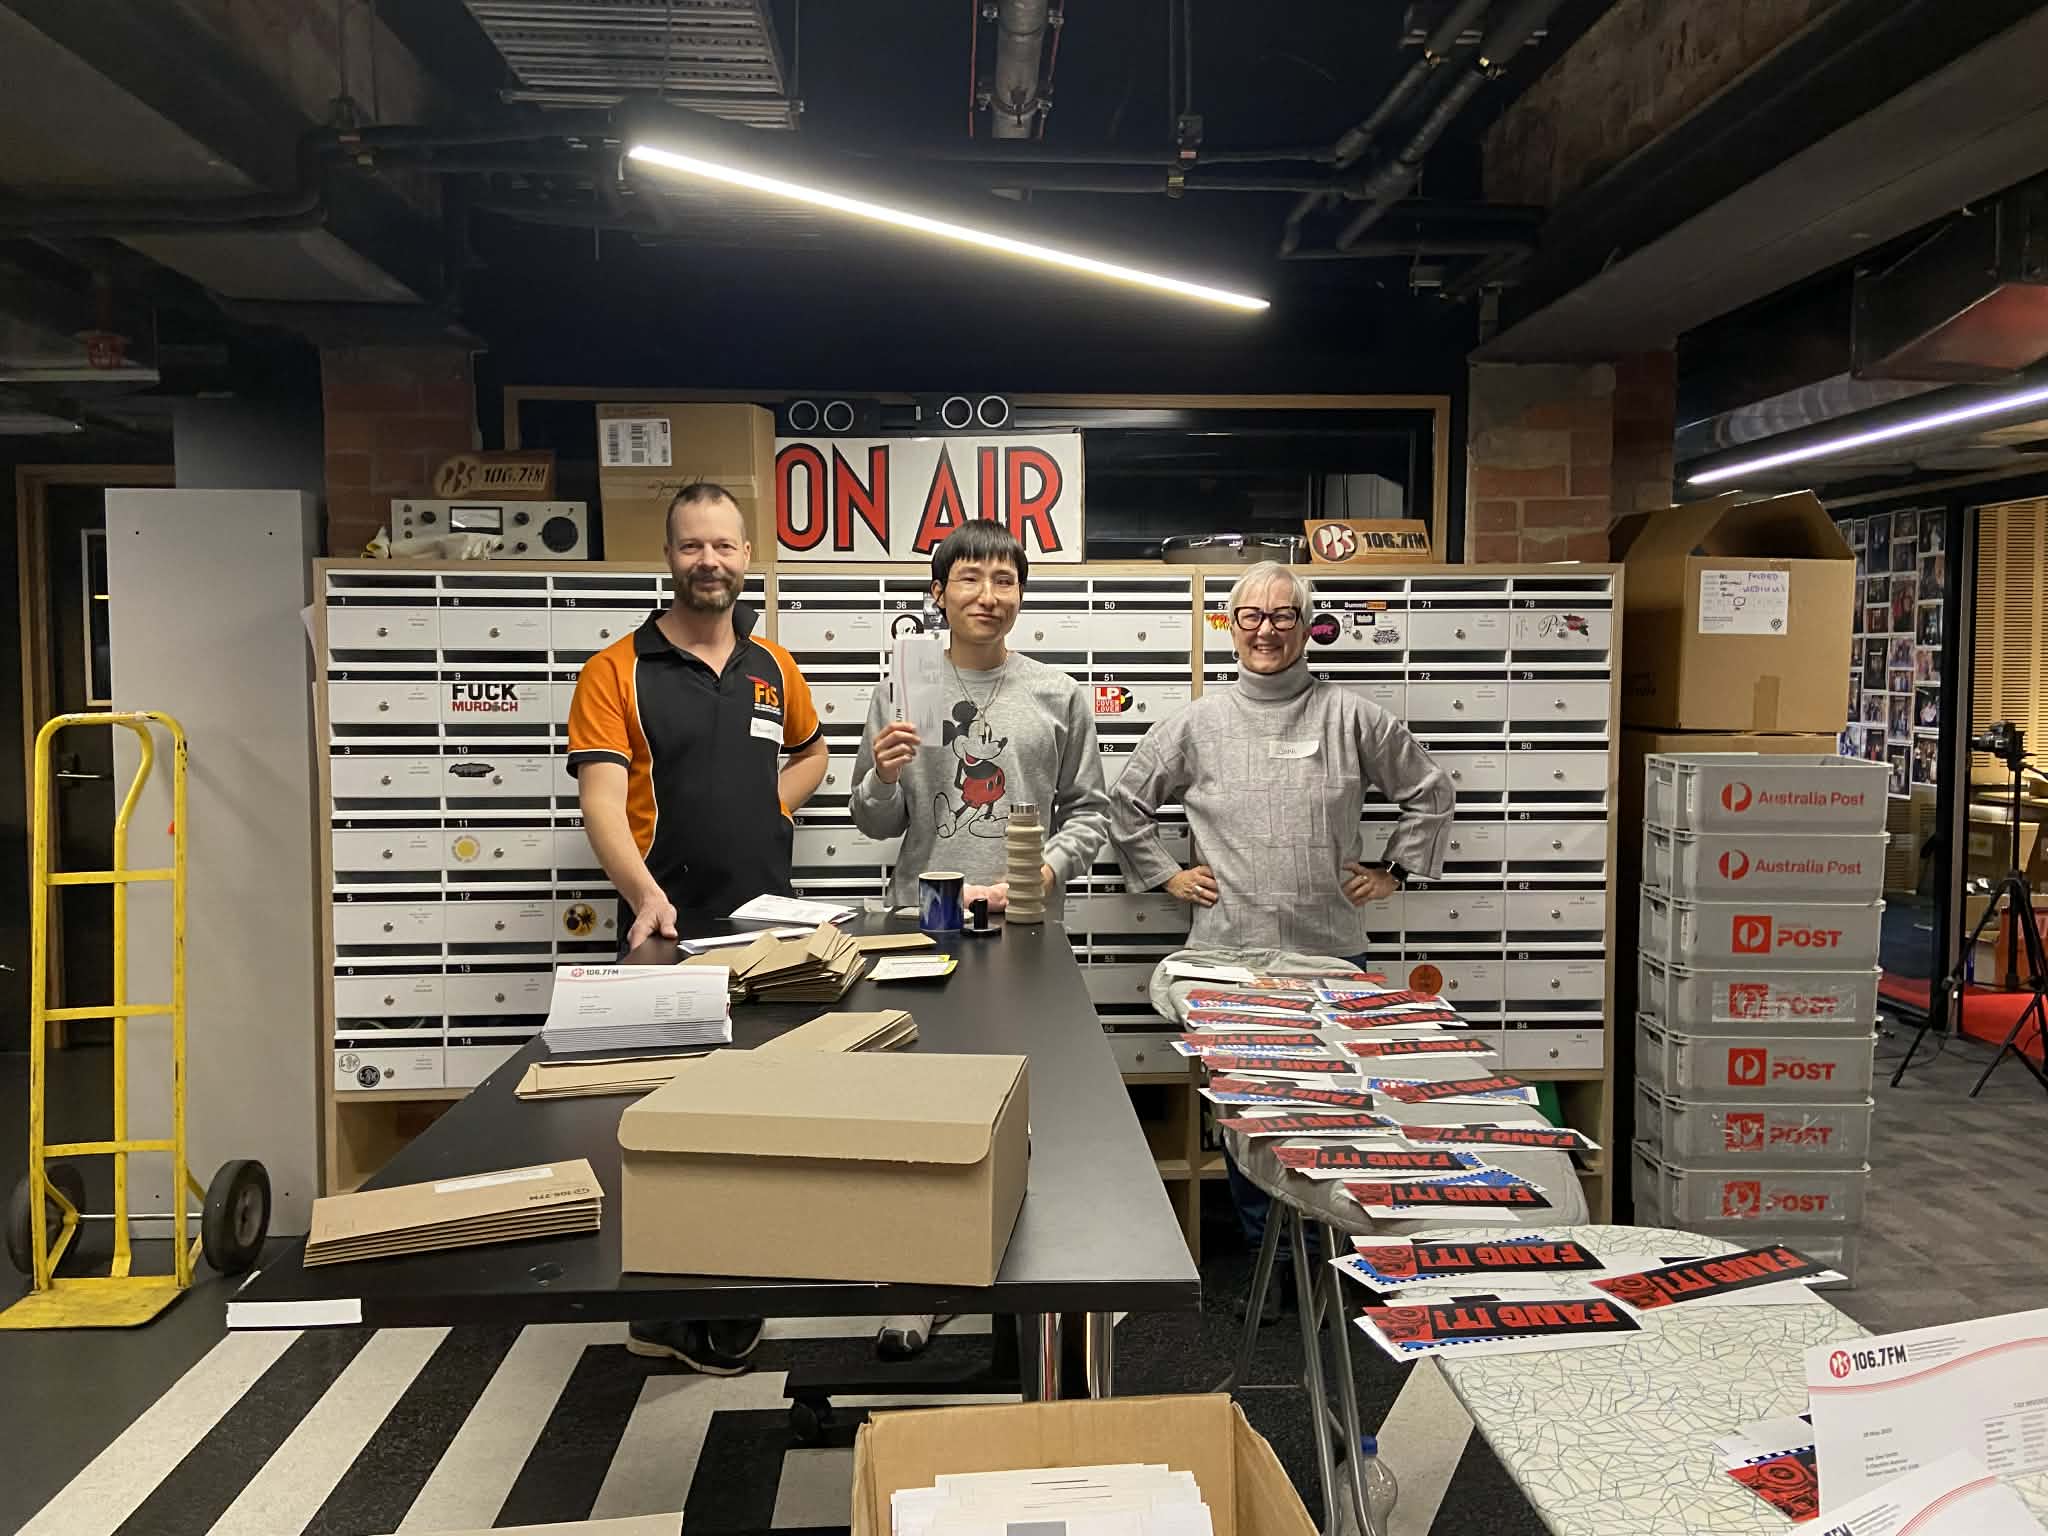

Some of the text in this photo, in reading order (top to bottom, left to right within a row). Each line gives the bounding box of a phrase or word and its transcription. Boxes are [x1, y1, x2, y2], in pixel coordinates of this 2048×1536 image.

[776, 441, 1063, 556] ON AIR
[1317, 525, 1426, 560] PBS 106.7FM
[566, 598, 576, 608] 15
[790, 601, 802, 610] 29
[1104, 601, 1116, 610] 50
[1217, 601, 1228, 610] 57
[1422, 600, 1432, 608] 71
[1524, 600, 1535, 608] 78
[342, 672, 348, 680] 2
[455, 672, 461, 680] 9
[566, 672, 576, 681] 16
[1104, 674, 1114, 682] 51
[1217, 673, 1228, 681] 58
[1420, 672, 1430, 680] 72
[1522, 672, 1534, 680] 79
[452, 684, 519, 700] FUCK
[754, 682, 779, 707] FIS
[1096, 688, 1120, 700] LP
[452, 702, 518, 712] MURDCH
[344, 746, 350, 755] 3
[457, 746, 468, 754] 10
[1104, 744, 1114, 752] 52
[1758, 792, 1864, 806] Australia Post
[346, 820, 352, 828] 4
[458, 820, 469, 828] 11
[570, 818, 580, 826] 18
[1754, 858, 1862, 874] Australia Post
[346, 894, 353, 902] 5
[460, 892, 470, 900] 12
[1777, 930, 1843, 948] POST
[348, 967, 354, 976] 6
[460, 964, 471, 973] 13
[348, 1040, 355, 1048] 7
[460, 1037, 472, 1046] 14
[1772, 1062, 1836, 1081] POST
[1290, 1089, 1368, 1106] FANG
[1302, 1114, 1374, 1127] FANG
[1444, 1128, 1577, 1146] FANG IT!
[1769, 1126, 1832, 1145] POST
[1320, 1152, 1451, 1166] FANG IT!
[1393, 1186, 1537, 1202] FANG IT!
[1765, 1194, 1829, 1212] POST
[1416, 1244, 1585, 1268] FANG IT!
[1655, 1249, 1809, 1295] FANG IT!
[1434, 1302, 1620, 1331] FANG IT!
[1830, 1350, 1850, 1378] PBS
[1852, 1344, 1907, 1371] 106.7FM
